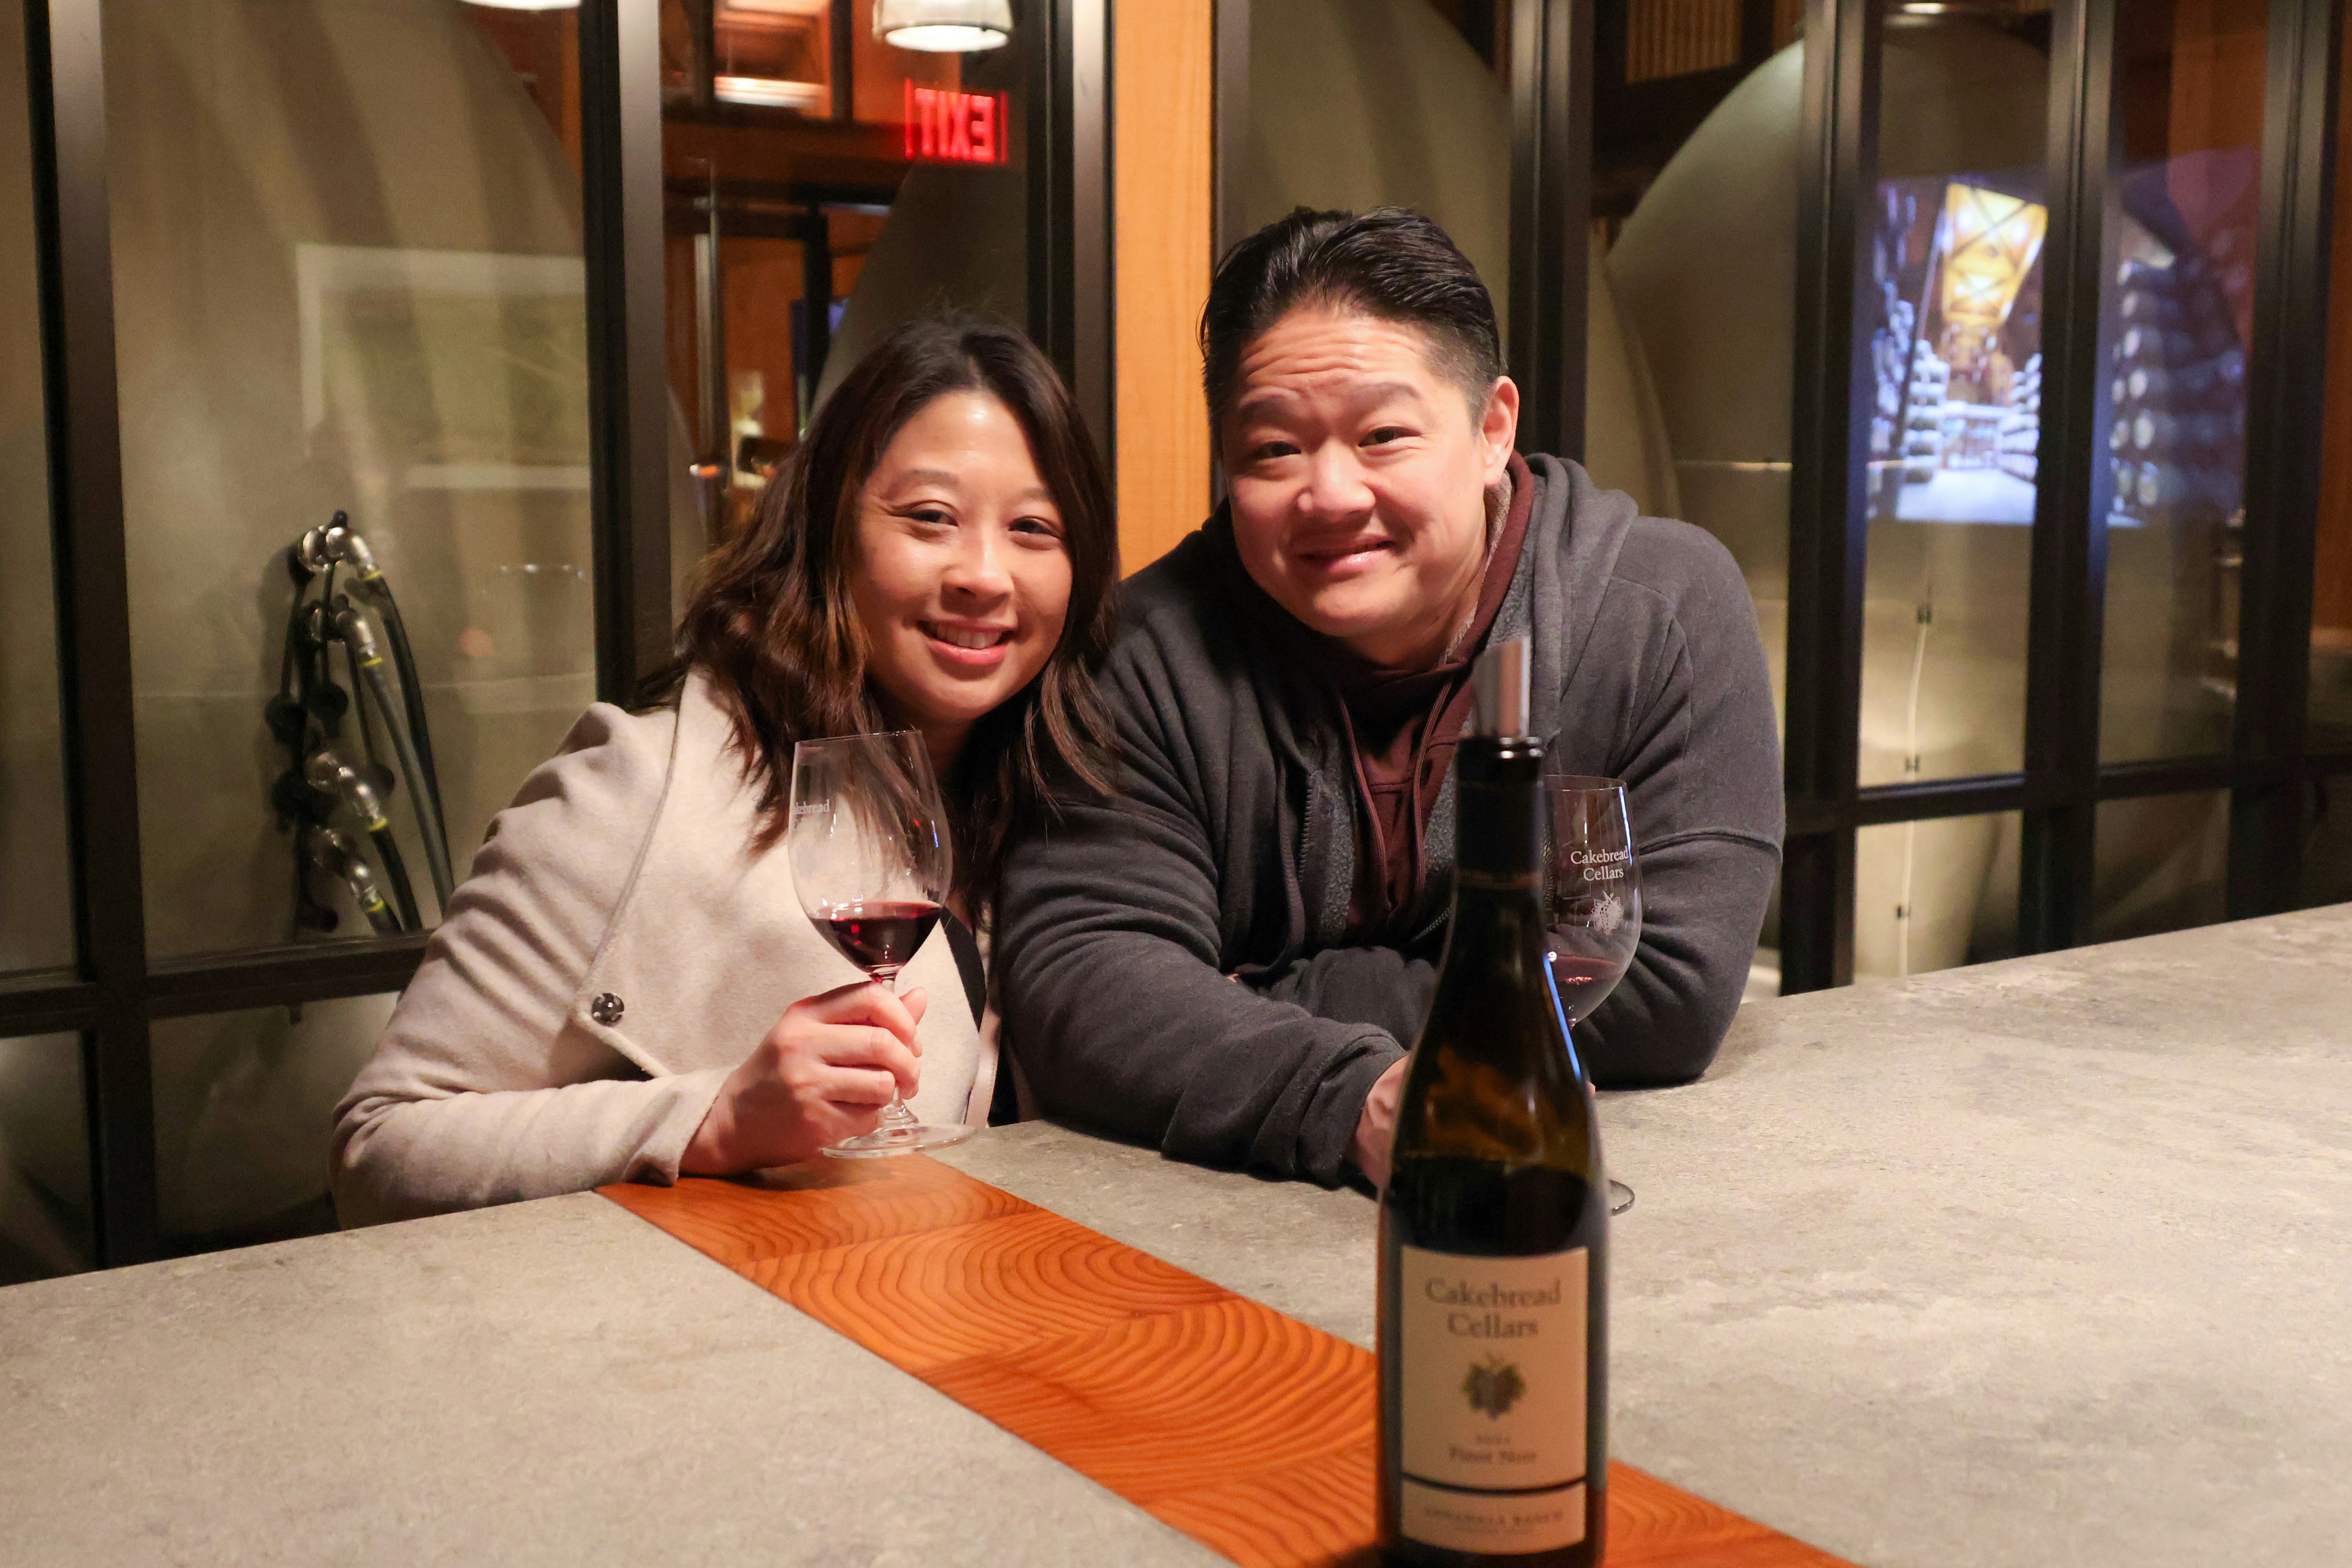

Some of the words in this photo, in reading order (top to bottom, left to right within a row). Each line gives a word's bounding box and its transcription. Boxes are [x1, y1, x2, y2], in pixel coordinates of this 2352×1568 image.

[795, 799, 830, 814] kebread
[1570, 845, 1630, 865] Cakebread
[1583, 865, 1624, 881] Cellars
[1425, 1276, 1561, 1307] Cakebread
[1447, 1312, 1539, 1339] Cellars
